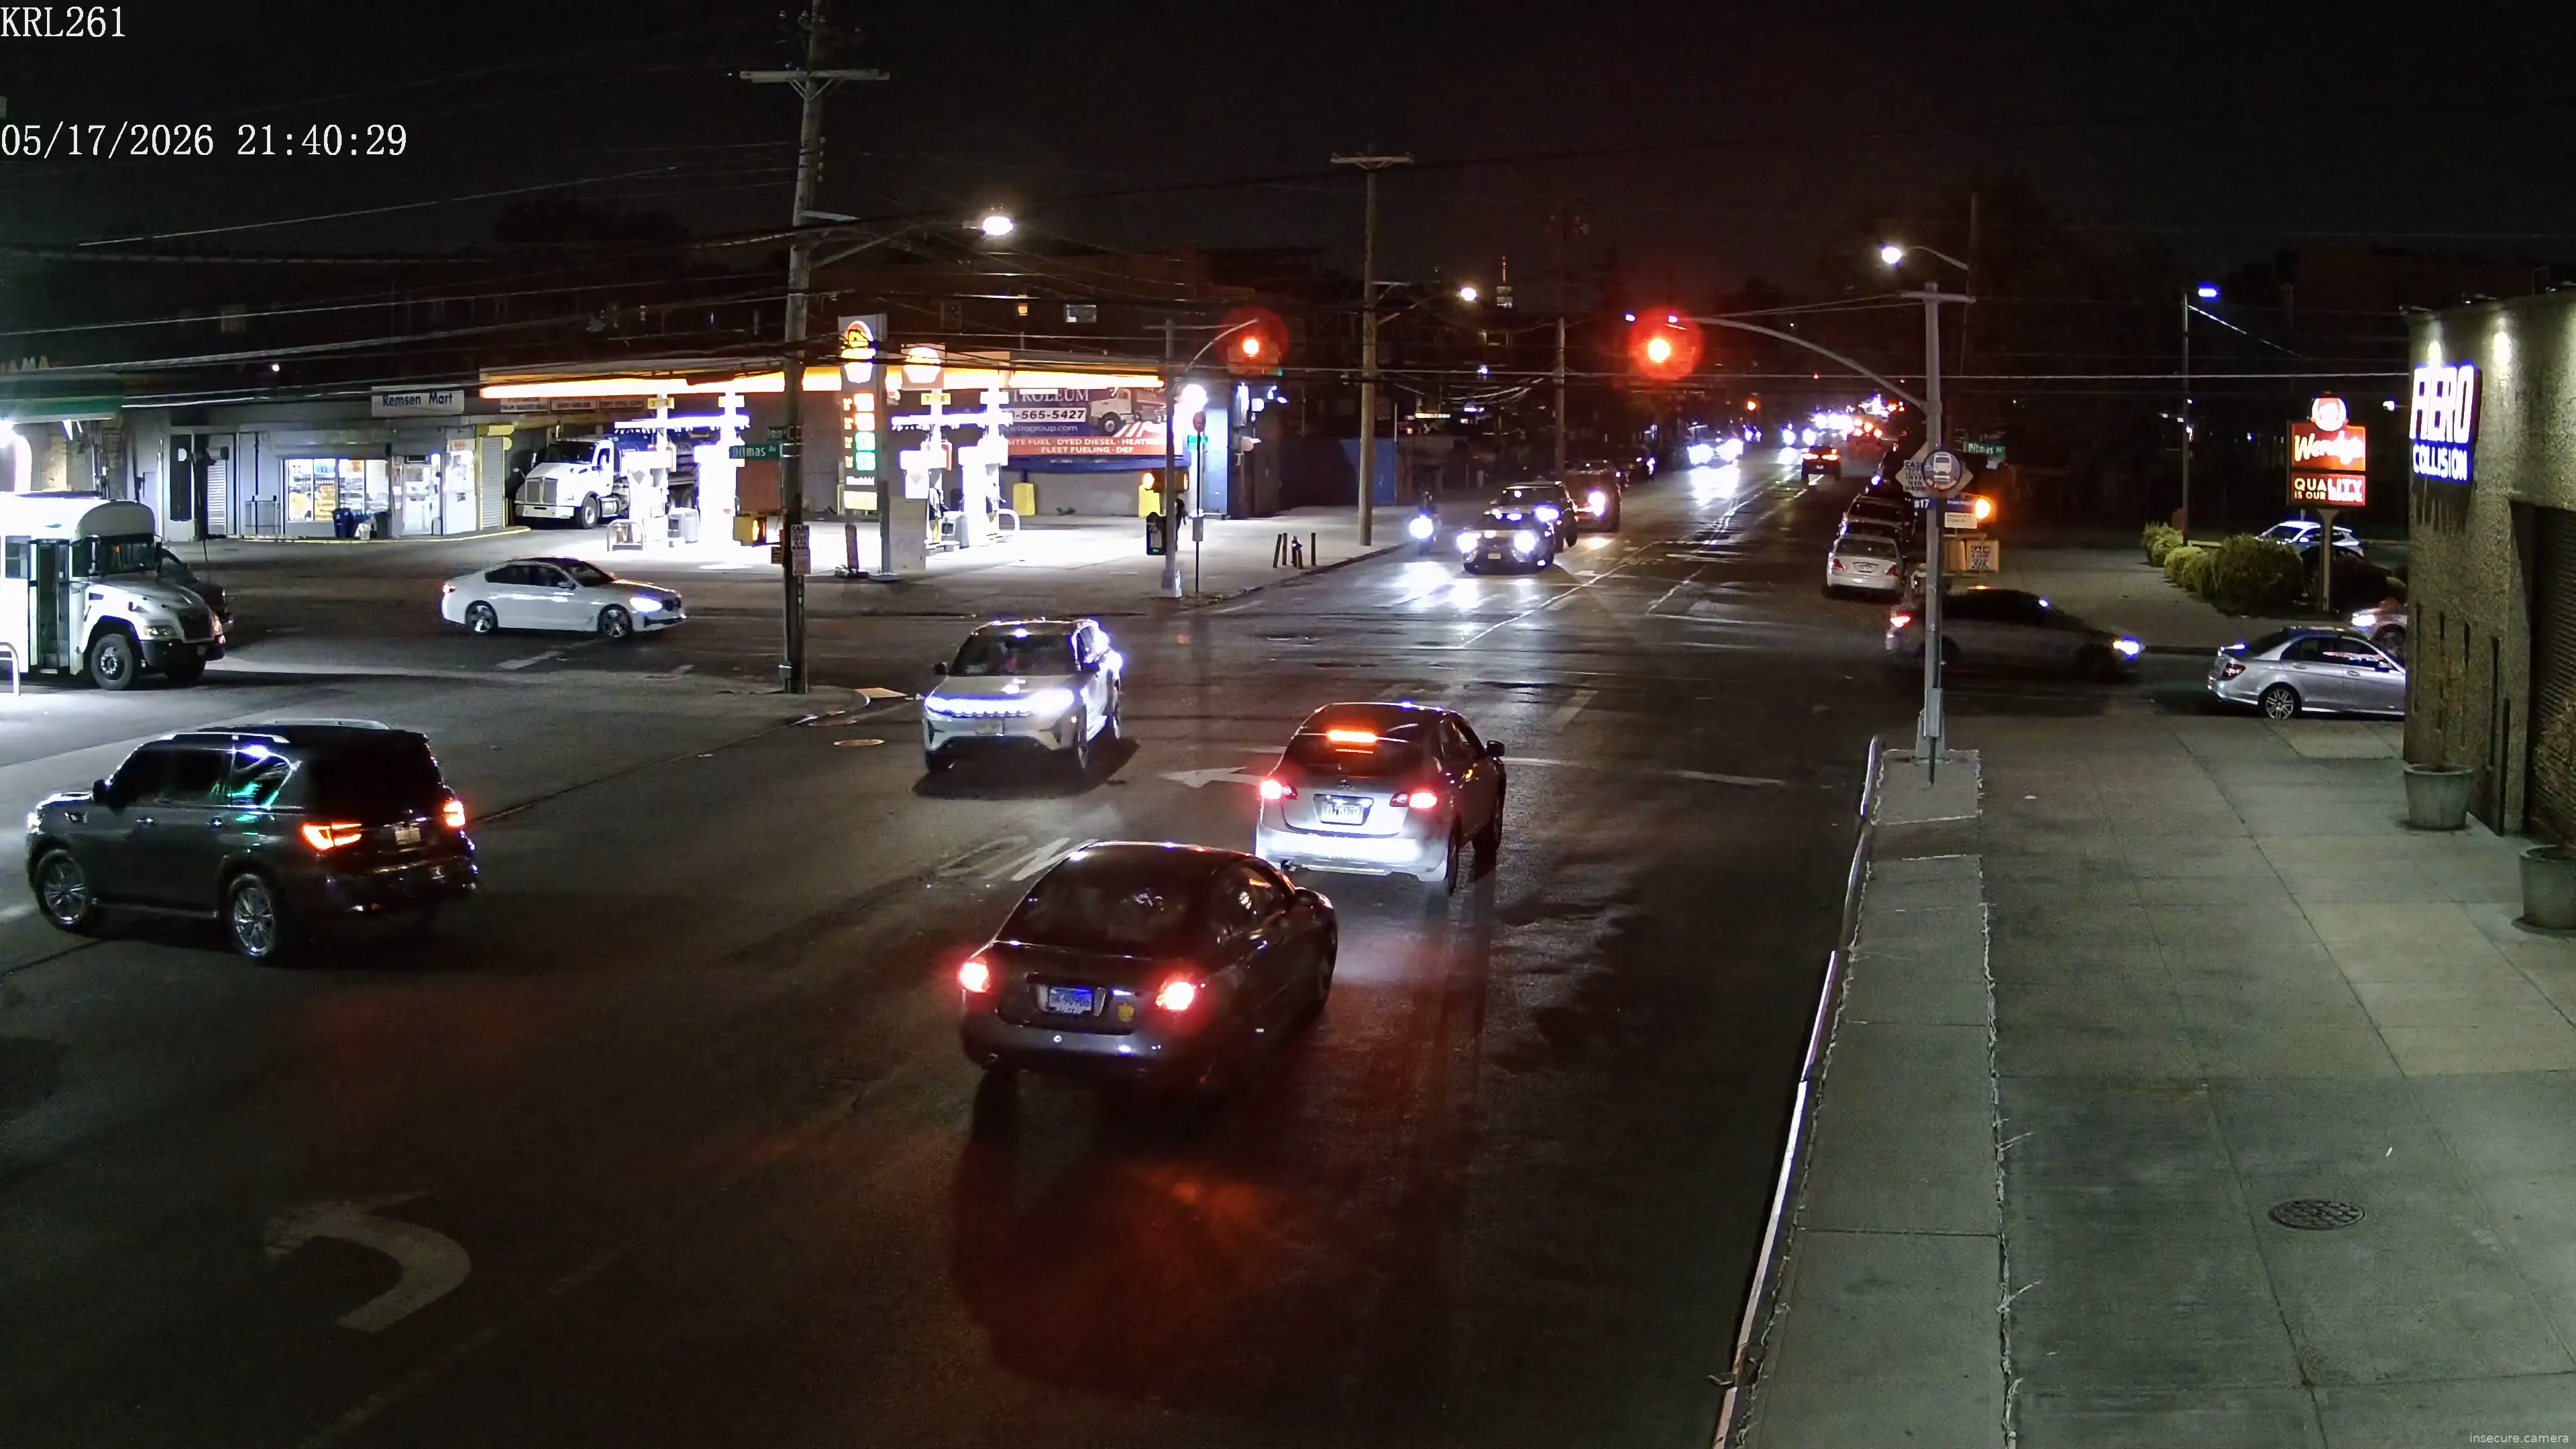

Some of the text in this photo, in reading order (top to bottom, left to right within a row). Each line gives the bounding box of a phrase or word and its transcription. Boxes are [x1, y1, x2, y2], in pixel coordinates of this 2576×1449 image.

[383, 391, 452, 407] Remsen Mart
[1012, 389, 1089, 402] TROLEUM
[1012, 410, 1085, 419] -565-5427
[733, 446, 765, 457] Ditmas
[2413, 445, 2467, 480] COLLISION
[2294, 478, 2363, 492] QUALITY
[2306, 492, 2326, 500] OUR
